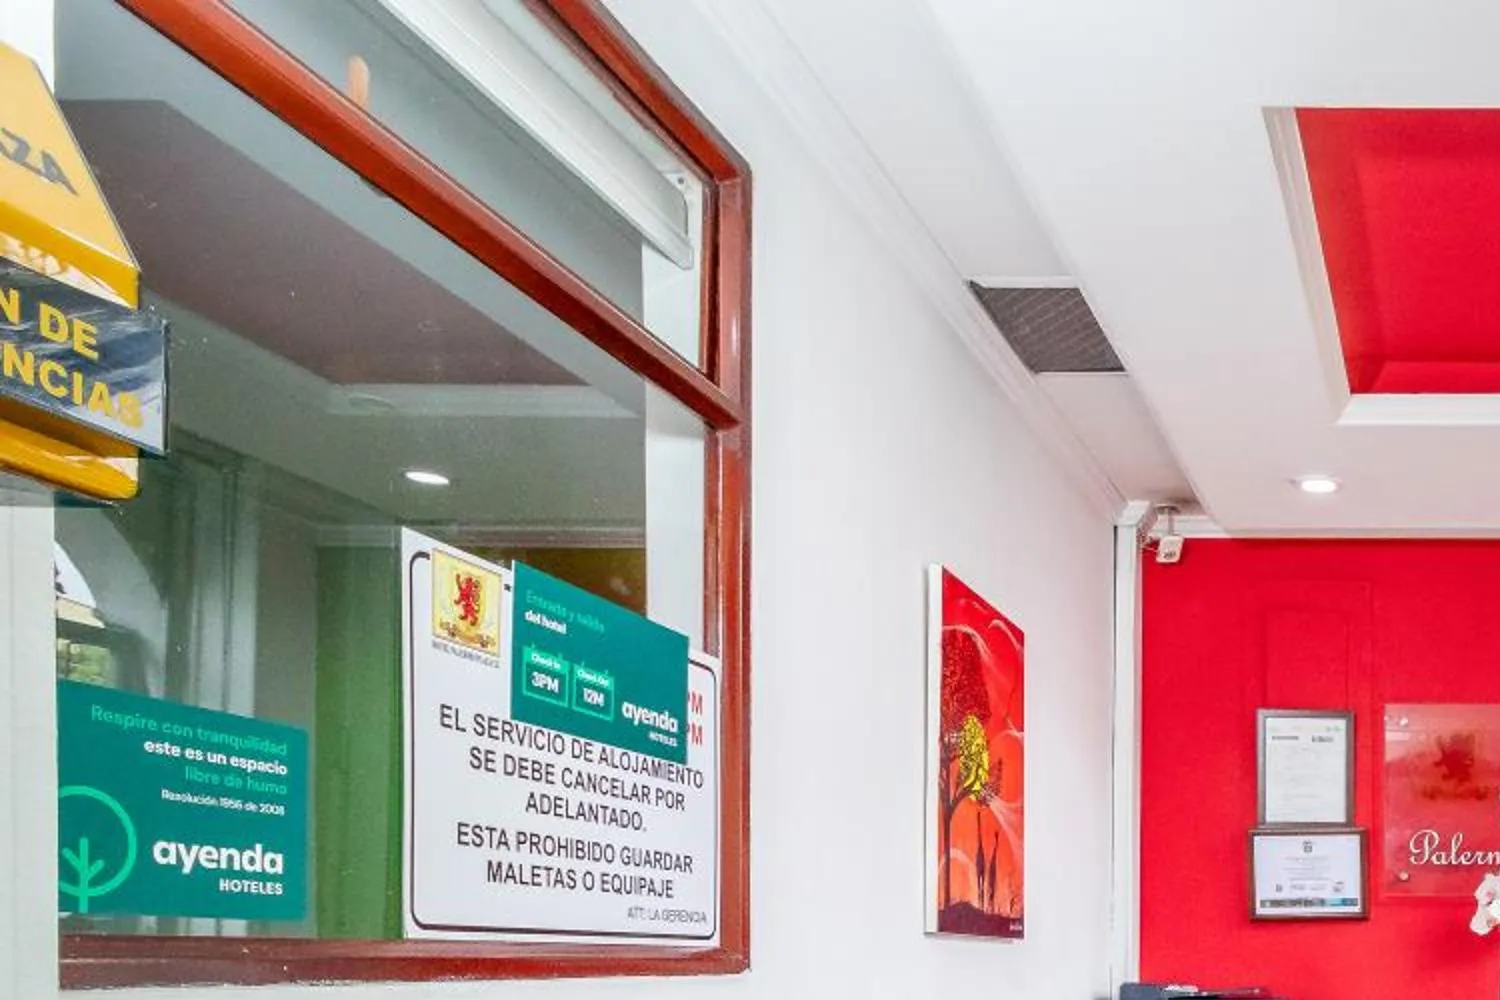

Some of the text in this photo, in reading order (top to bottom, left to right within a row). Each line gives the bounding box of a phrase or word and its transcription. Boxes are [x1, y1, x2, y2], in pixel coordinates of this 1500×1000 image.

[38, 301, 99, 361] DE
[0, 341, 143, 428] NCIAS
[531, 671, 559, 693] 3PM
[622, 701, 679, 733] ayenda
[687, 691, 703, 716] M
[91, 704, 288, 757] Respire con tranquilidad
[439, 703, 704, 789] EL SERVICIO DE ALOJAMIENTO
[144, 739, 288, 776] este es un espacio
[185, 766, 288, 796] libre de humo
[469, 746, 685, 811] SE DEBE CANCELAR POR
[526, 792, 647, 832] ADELANTADO.
[152, 839, 284, 875] ayenda
[457, 822, 693, 874] ESTA PROHIBIDO GUARDAR
[218, 879, 284, 896] HOTELES
[487, 860, 674, 899] MALETAS O EQUIPAJE
